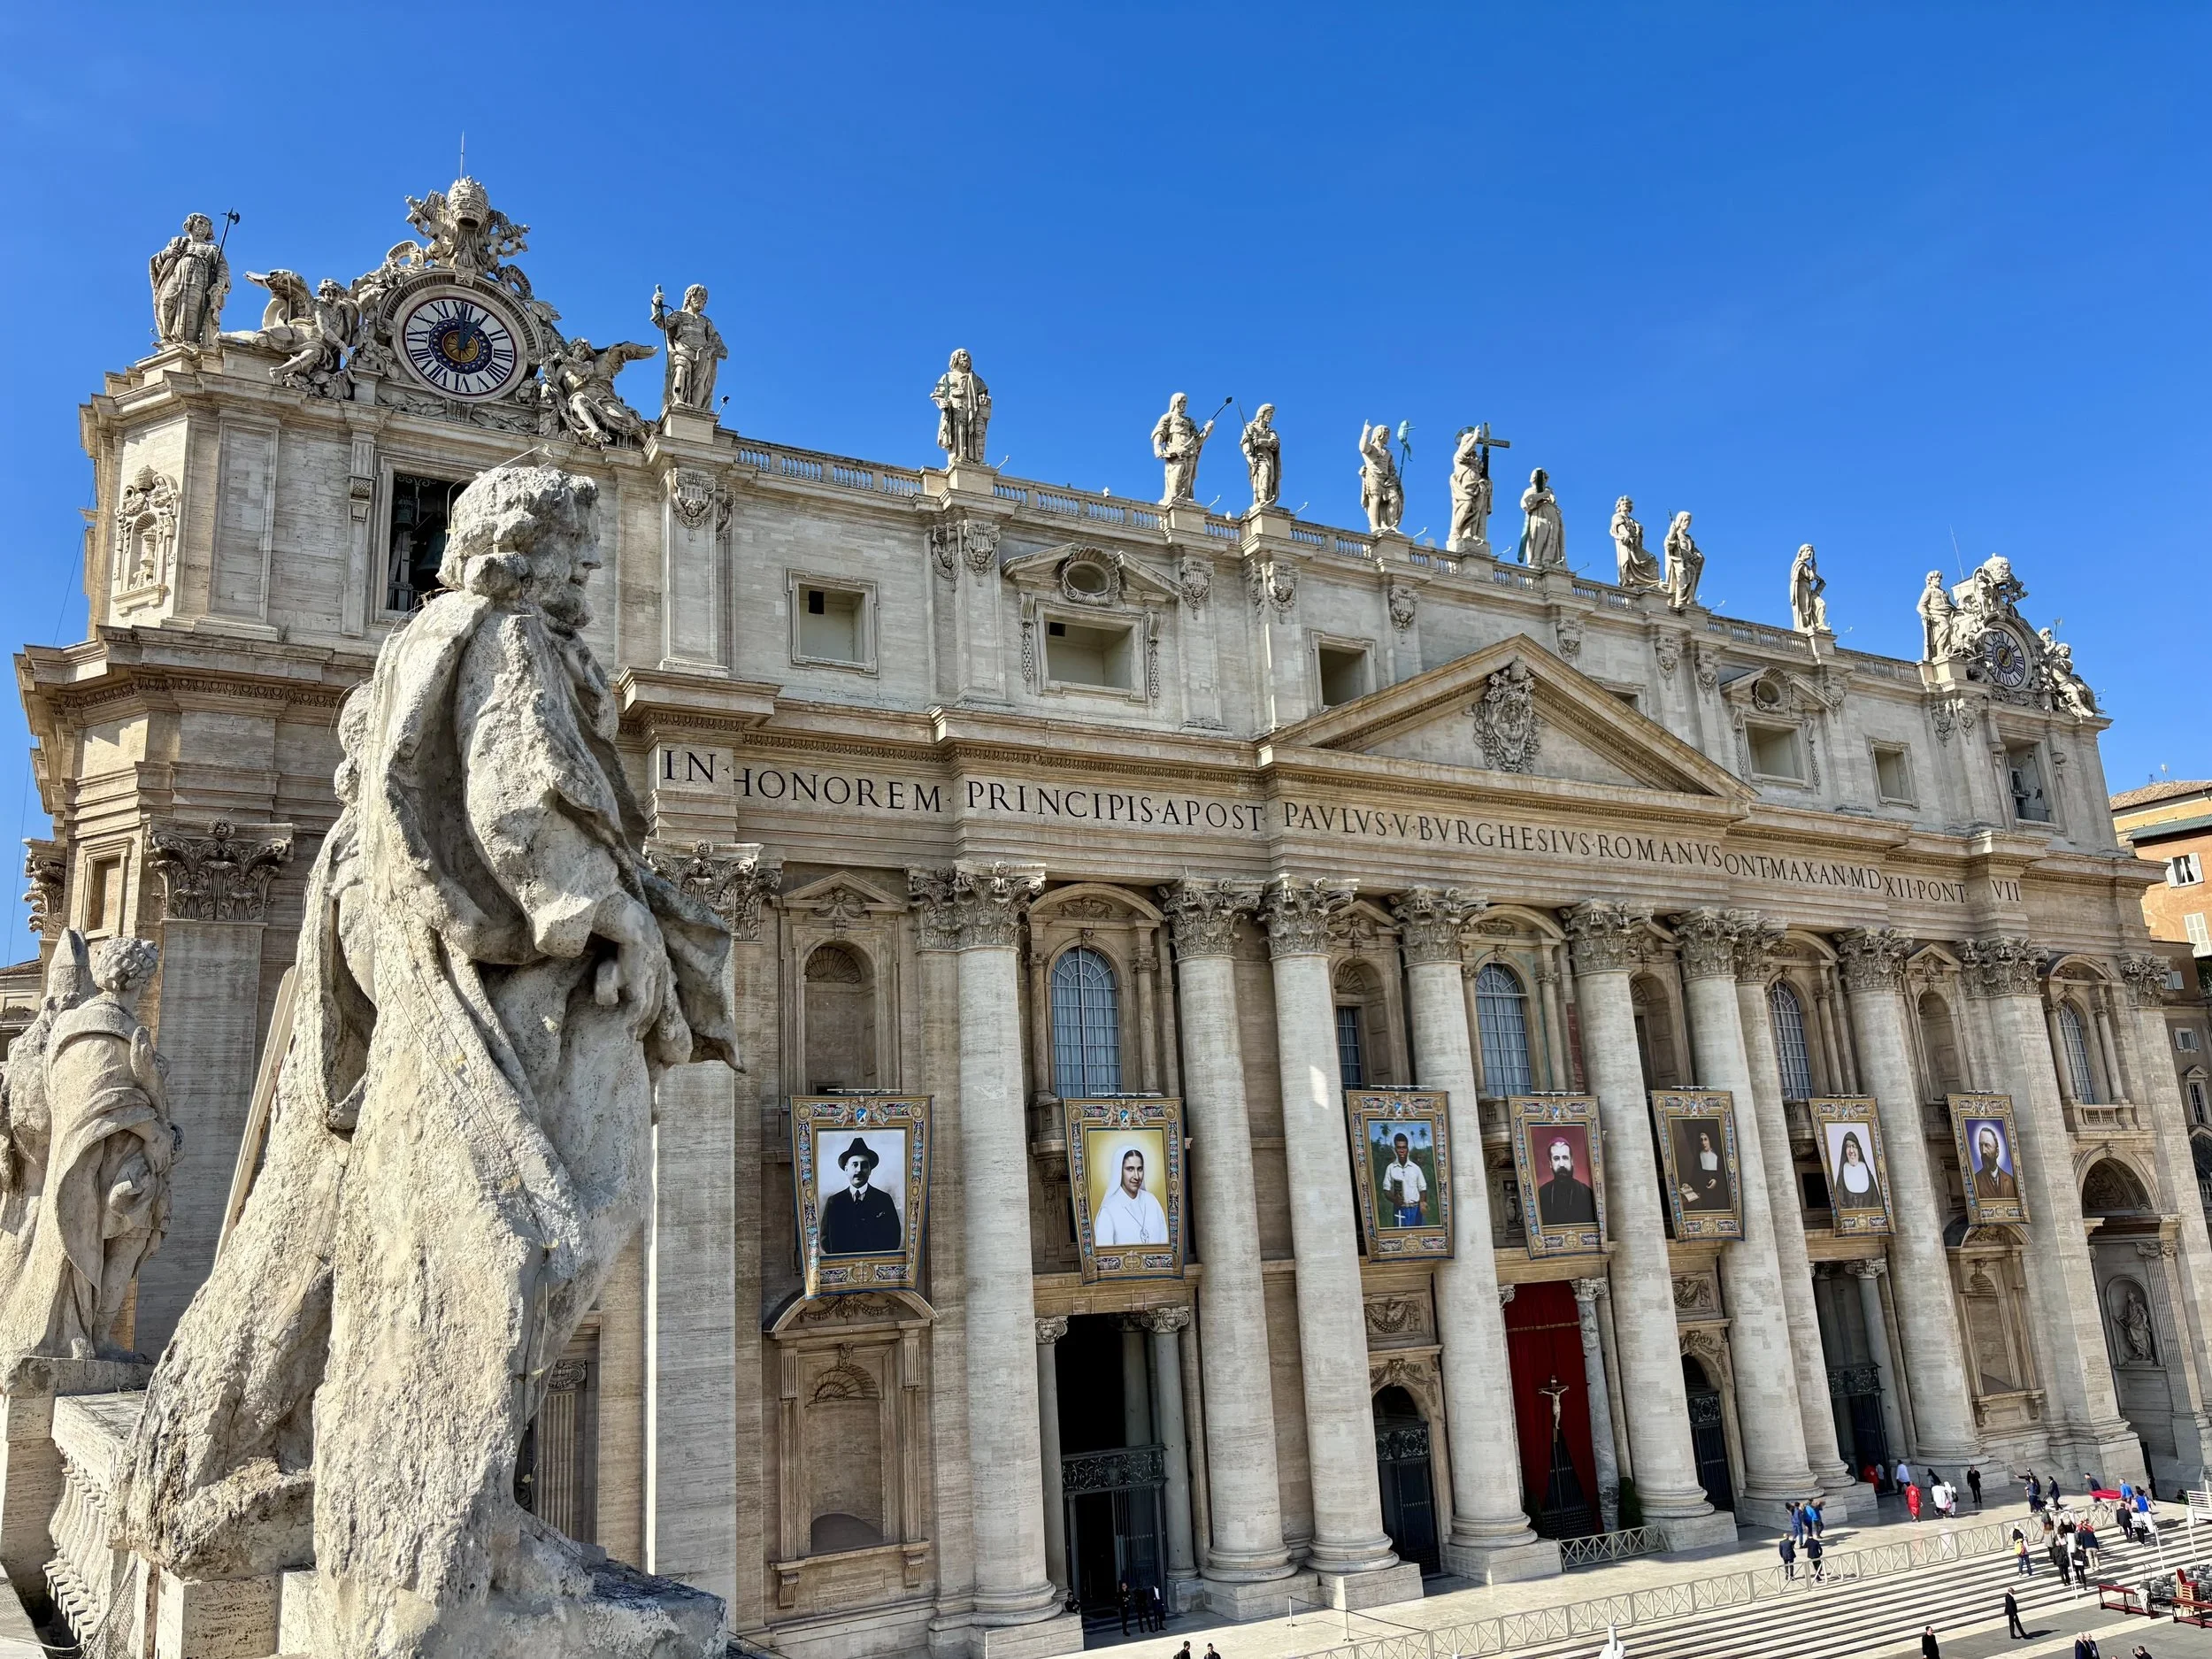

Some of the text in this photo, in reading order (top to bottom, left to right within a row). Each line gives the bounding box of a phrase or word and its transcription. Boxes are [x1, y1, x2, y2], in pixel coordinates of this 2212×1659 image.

[429, 301, 450, 321] XI
[488, 328, 509, 342] II
[494, 349, 513, 363] III
[453, 373, 472, 392] VI
[476, 374, 491, 391] V
[664, 750, 717, 783] IN
[733, 767, 942, 813] HONOREM
[966, 780, 1153, 823] PRINCIPIS
[1161, 799, 1263, 832] APOST
[1283, 802, 1386, 837] PAVLVS
[1392, 813, 1410, 838] V
[1417, 816, 1590, 856] BVRGHESIVS
[1596, 833, 1722, 867] ROMANVS
[1724, 853, 1769, 878] ONT
[1770, 856, 1817, 883] MAX
[1819, 864, 1847, 887] AN
[1916, 879, 1965, 903] PONT
[1991, 879, 2021, 902] VII
